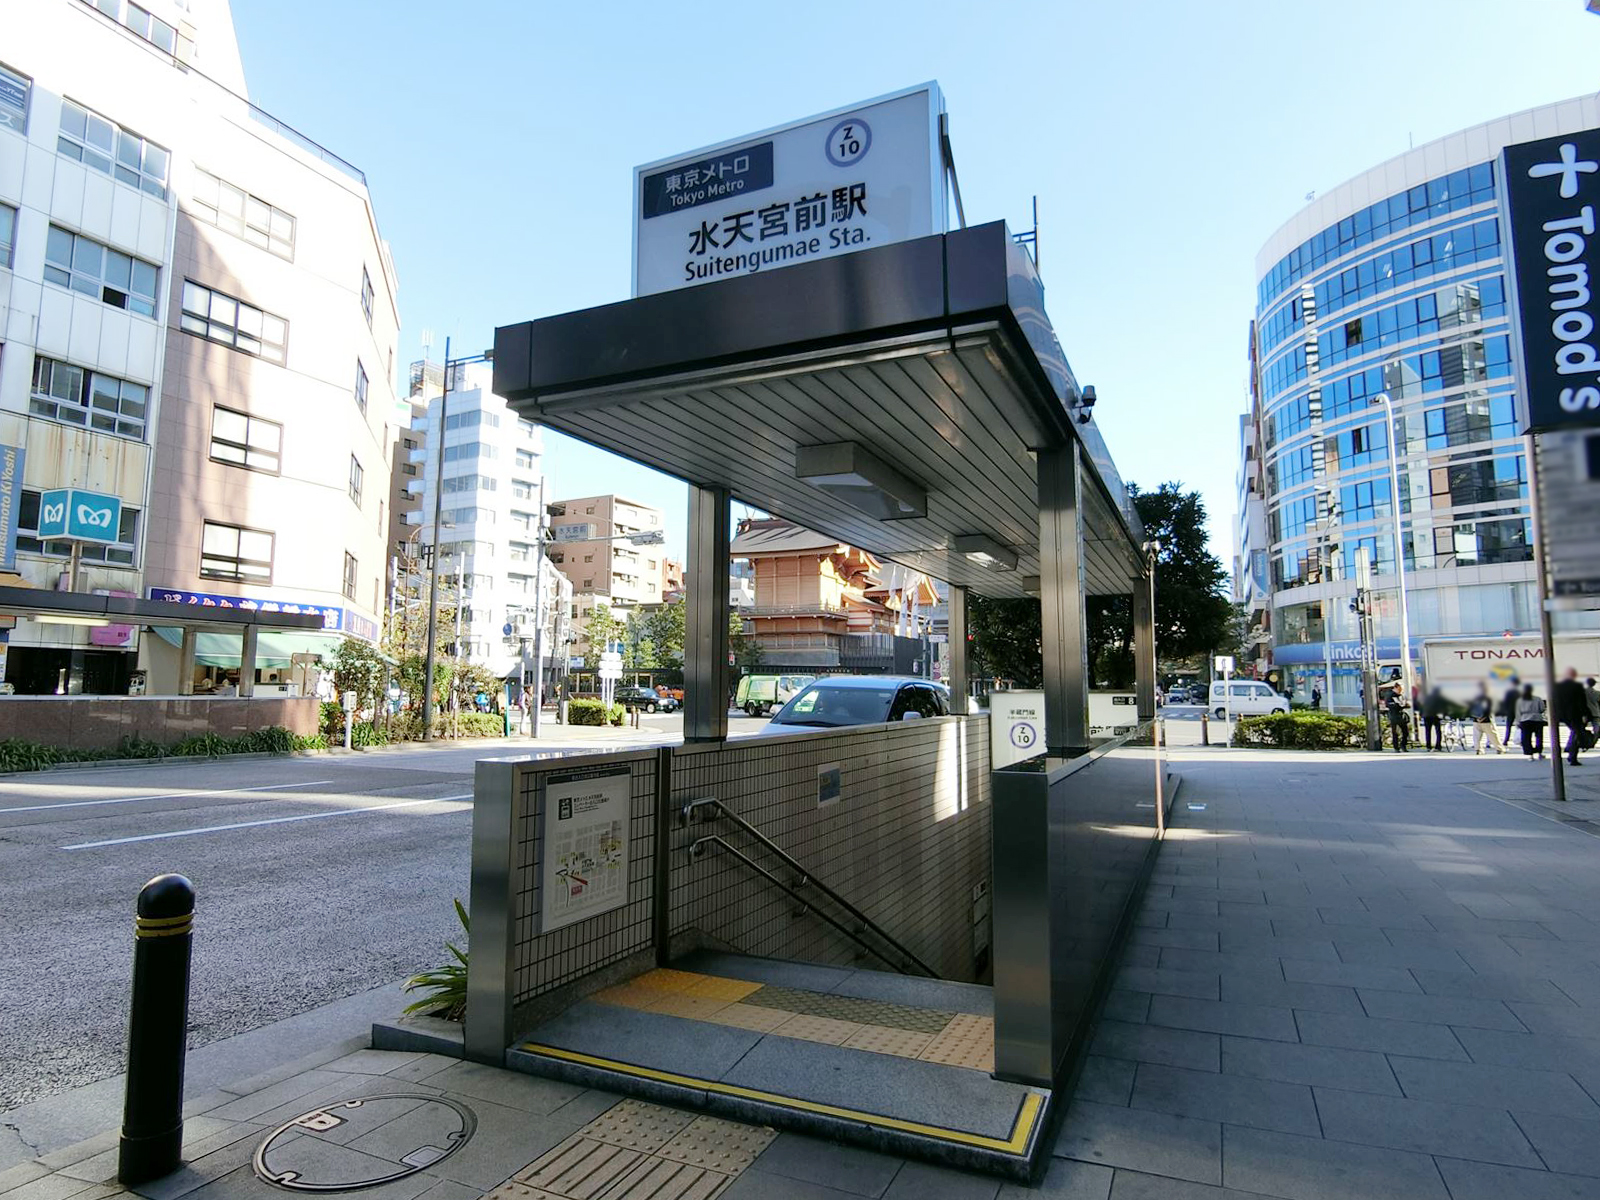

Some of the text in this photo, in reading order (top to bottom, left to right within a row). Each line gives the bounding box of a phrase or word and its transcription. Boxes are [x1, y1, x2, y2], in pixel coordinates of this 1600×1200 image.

[843, 126, 854, 141] Z
[839, 140, 860, 157] 10
[665, 155, 749, 193] 東京メトロ
[670, 179, 744, 207] Tokyo Metro
[688, 182, 868, 256] 水天宮前駅
[685, 227, 872, 282] Suitengumae Sta.
[1454, 649, 1549, 660] TONAM
[1128, 697, 1135, 705] 8
[1020, 726, 1026, 735] Z
[1017, 735, 1030, 743] 10
